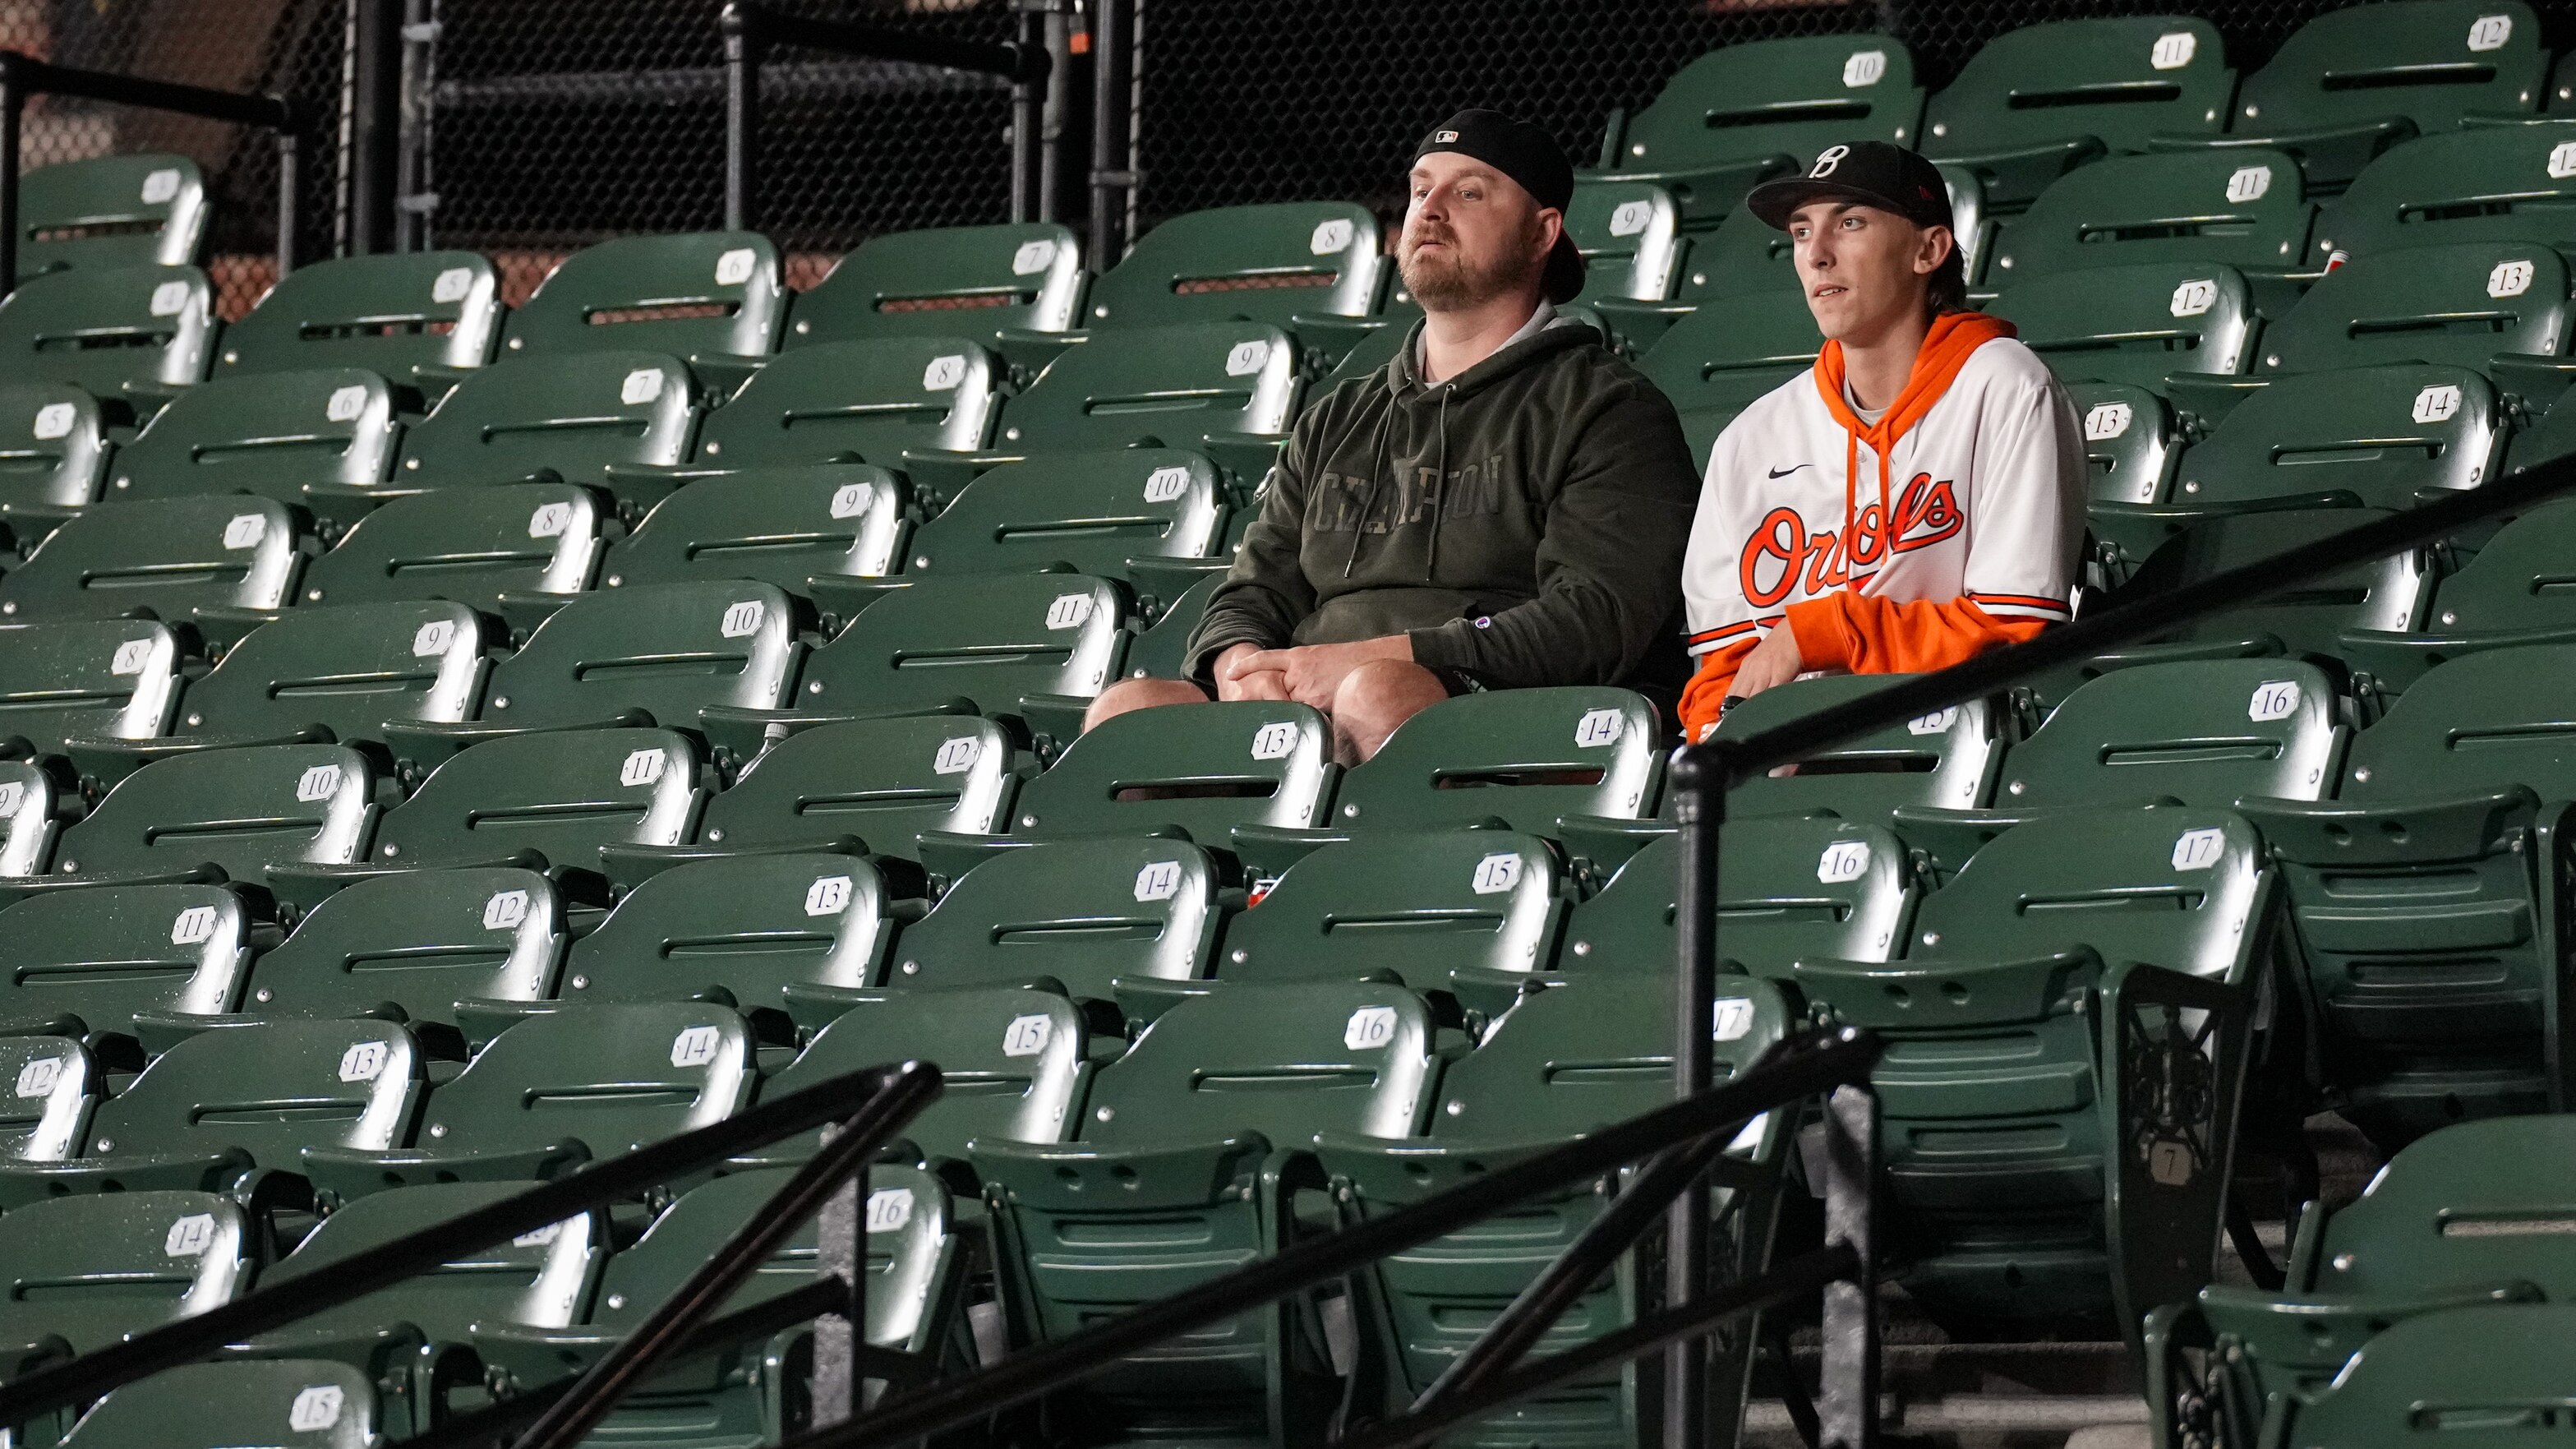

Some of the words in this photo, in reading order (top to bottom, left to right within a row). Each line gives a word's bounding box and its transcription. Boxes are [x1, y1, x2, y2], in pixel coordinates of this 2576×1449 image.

[2480, 21, 2501, 44] 12
[2164, 40, 2181, 62] 11
[1855, 58, 1877, 82] 10
[1809, 145, 1850, 178] B
[2239, 173, 2258, 196] 11
[1625, 209, 1635, 228] 9
[1325, 228, 1337, 247] 8
[730, 257, 740, 277] 6
[1030, 247, 1041, 267] 7
[446, 275, 458, 294] 5
[2500, 267, 2521, 290] 13
[2183, 286, 2205, 310] 12
[1242, 348, 1252, 368] 9
[938, 362, 950, 383] 8
[638, 376, 649, 396] 7
[341, 394, 353, 414] 6
[2425, 392, 2449, 416] 14
[49, 411, 61, 431] 5
[2095, 410, 2117, 433] 13
[1154, 473, 1178, 496] 10
[846, 490, 857, 511] 9
[240, 520, 252, 542] 7
[543, 510, 555, 530] 8
[1740, 472, 1964, 608] Oriols
[732, 607, 757, 632] 10
[1058, 599, 1078, 622] 11
[428, 627, 440, 649] 9
[125, 646, 138, 667] 8
[2262, 688, 2288, 713] 16
[1588, 716, 1612, 741] 14
[1263, 729, 1285, 753] 13
[632, 755, 652, 779] 11
[946, 743, 970, 767] 12
[308, 771, 331, 796] 10
[0, 789, 9, 810] 9
[2186, 836, 2213, 862] 17
[1486, 861, 1511, 886] 15
[1832, 849, 1859, 876] 16
[1146, 868, 1170, 894] 14
[817, 884, 840, 908] 13
[494, 897, 518, 922] 12
[182, 913, 204, 937] 11
[1359, 1013, 1385, 1041] 16
[1714, 1006, 1742, 1033] 17
[683, 1034, 708, 1059] 14
[1016, 1022, 1041, 1049] 15
[351, 1049, 375, 1074] 13
[27, 1064, 51, 1090] 12
[2164, 1149, 2175, 1176] 7
[874, 1197, 901, 1225] 16
[177, 1223, 203, 1249] 14
[303, 1393, 332, 1424] 15
